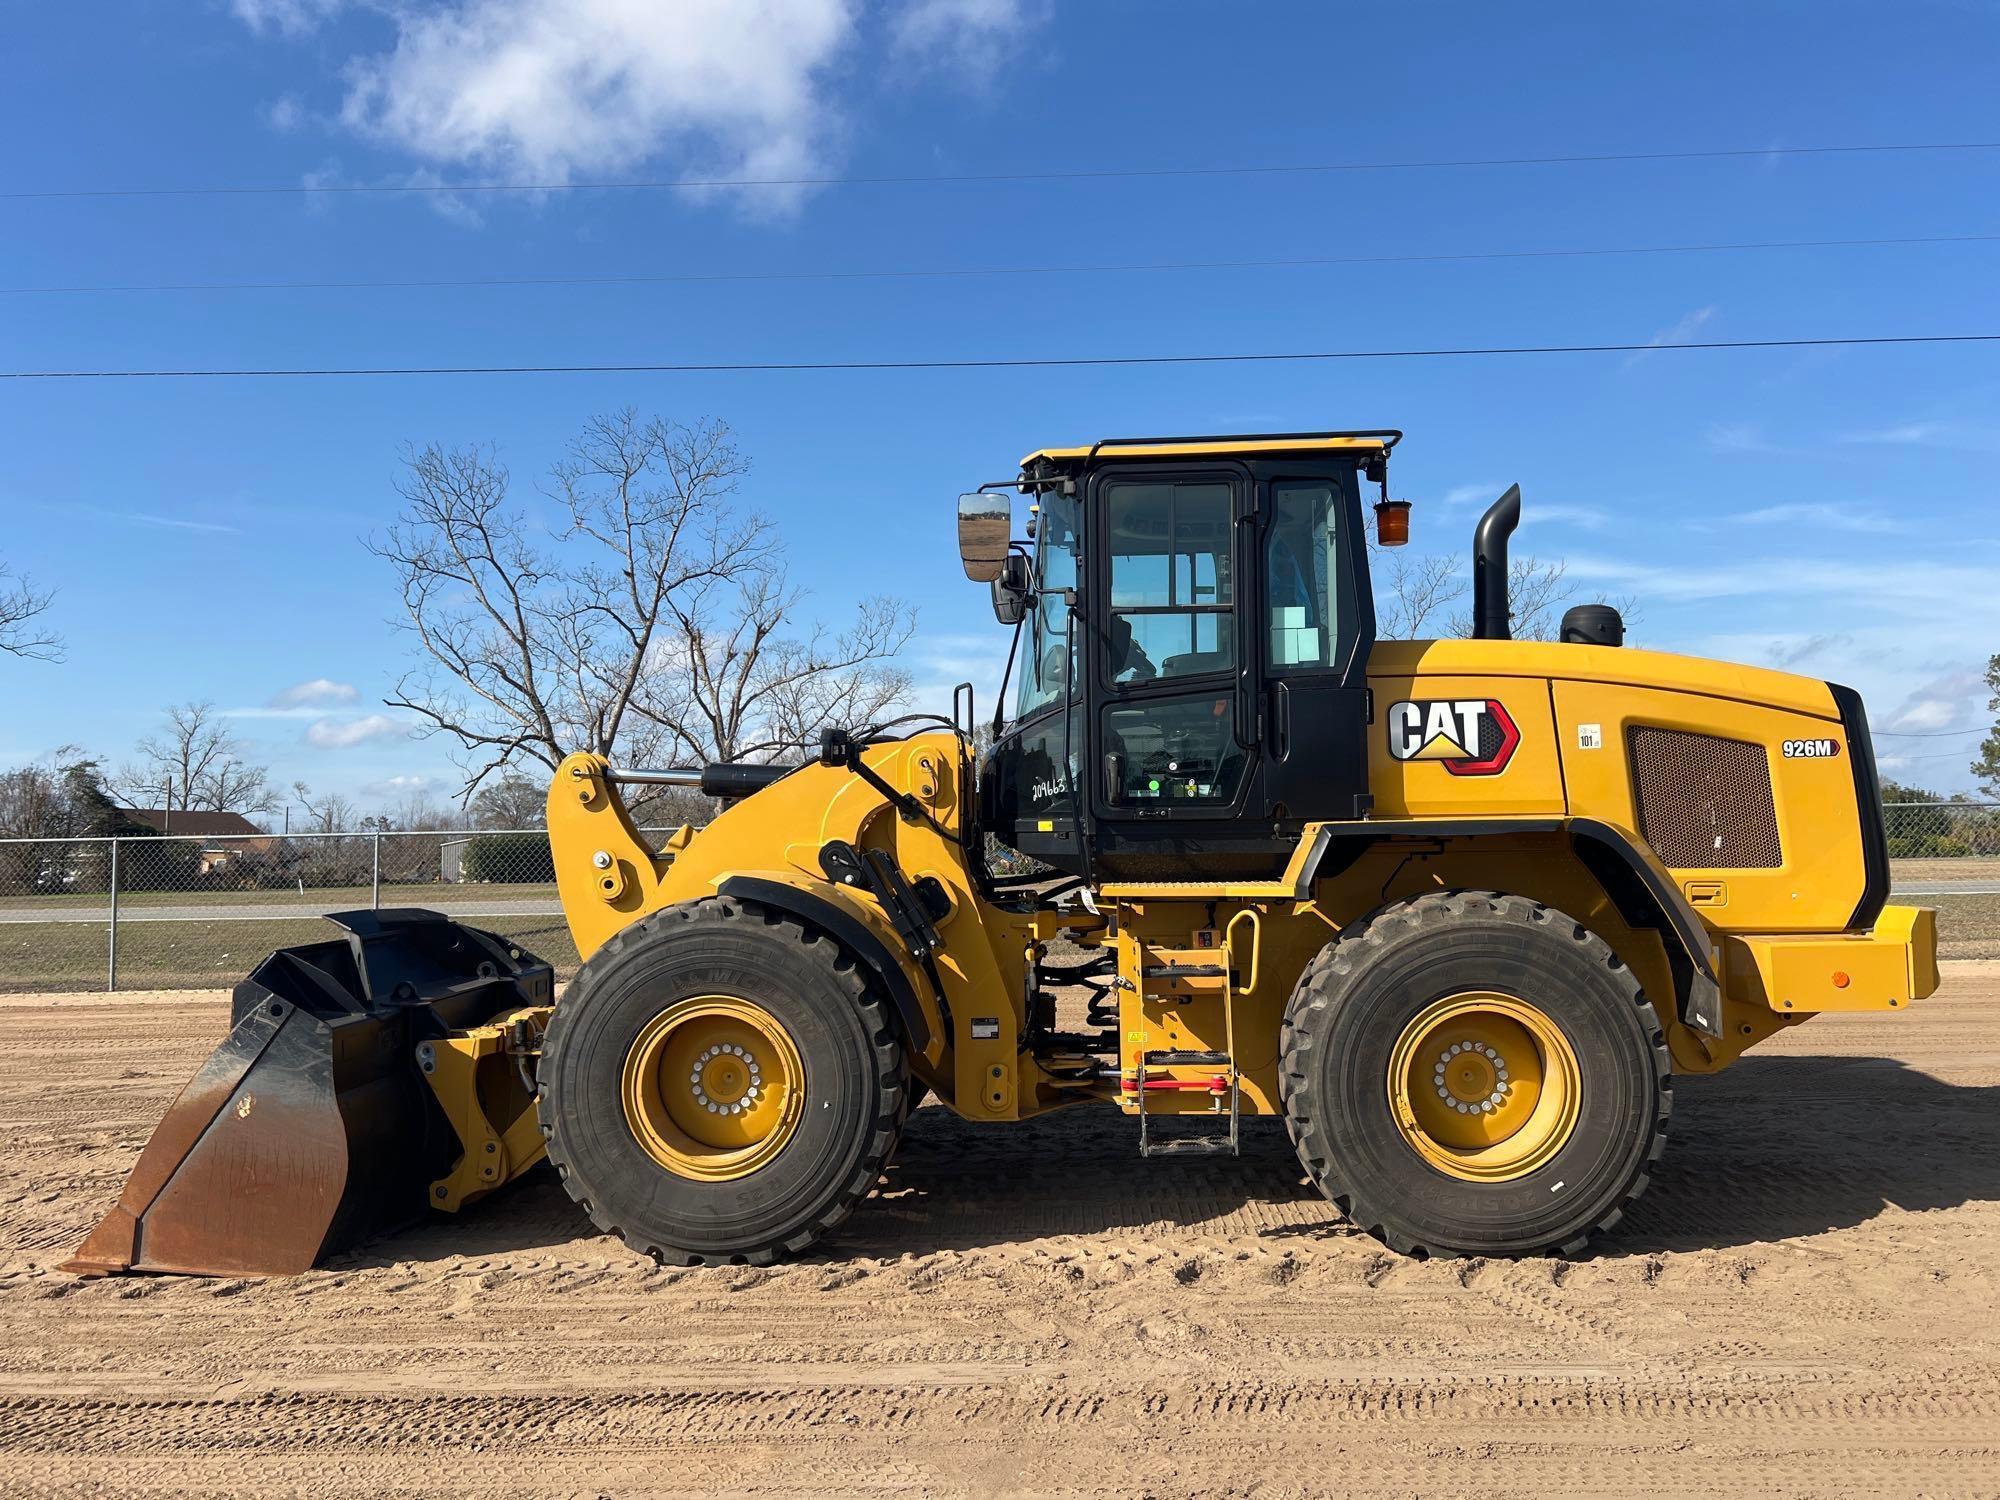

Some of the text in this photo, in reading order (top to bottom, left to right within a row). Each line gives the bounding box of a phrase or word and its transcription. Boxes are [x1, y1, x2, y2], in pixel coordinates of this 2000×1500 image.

[1389, 701, 1486, 759] CAT
[1581, 735, 1592, 747] 101
[1783, 740, 1831, 757] 926M
[1032, 778, 1066, 802] 209663
